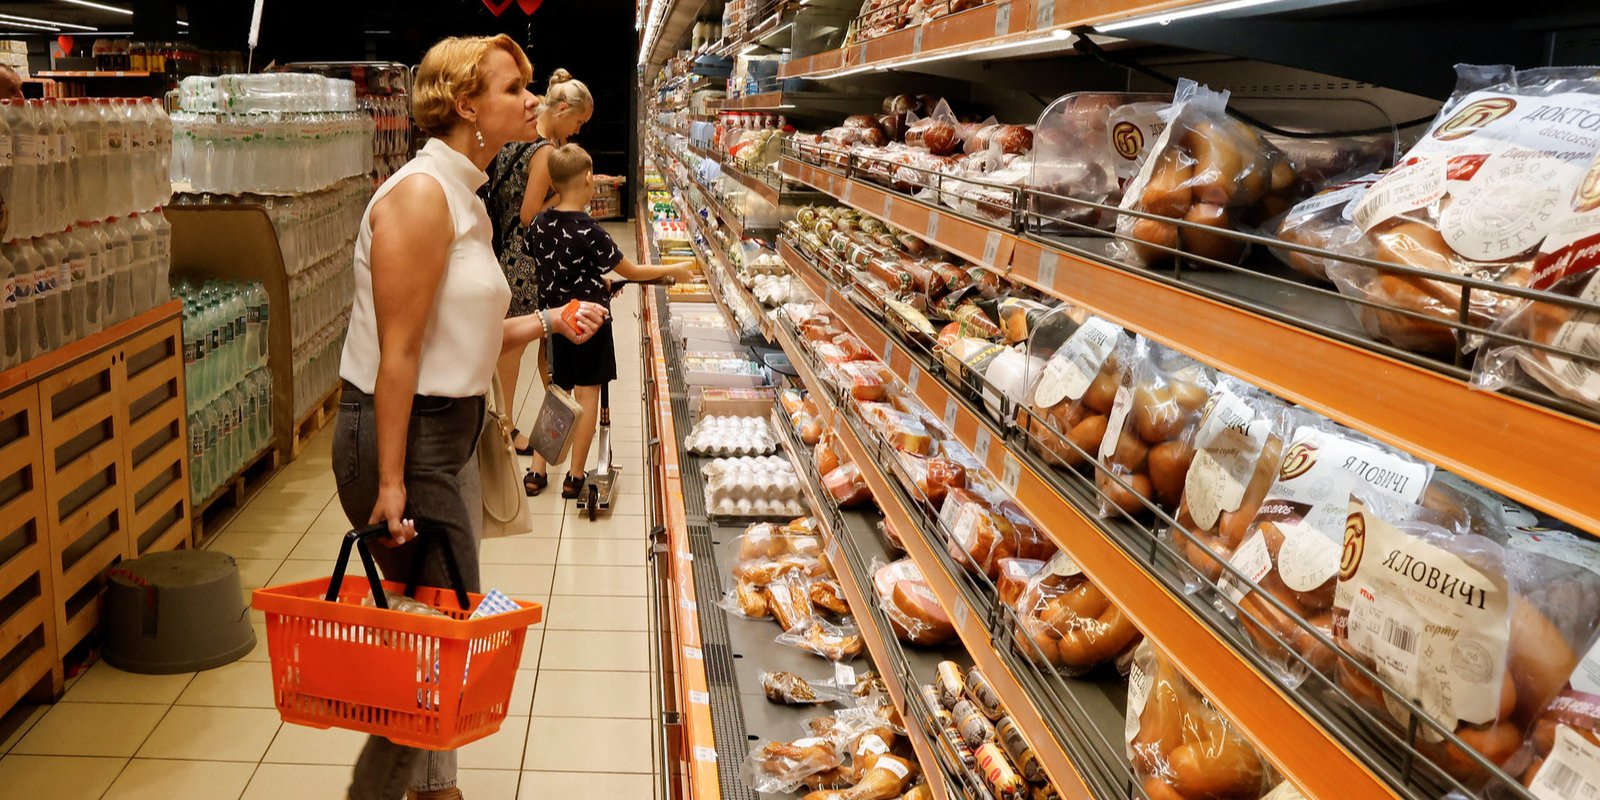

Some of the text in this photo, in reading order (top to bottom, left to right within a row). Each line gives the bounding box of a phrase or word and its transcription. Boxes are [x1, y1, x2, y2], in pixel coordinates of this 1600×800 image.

[1521, 105, 1600, 132] ДОКТО
[1343, 455, 1409, 494] ЯЛОВИЧІ
[1382, 549, 1486, 610] ЯЛОВИЧІ
